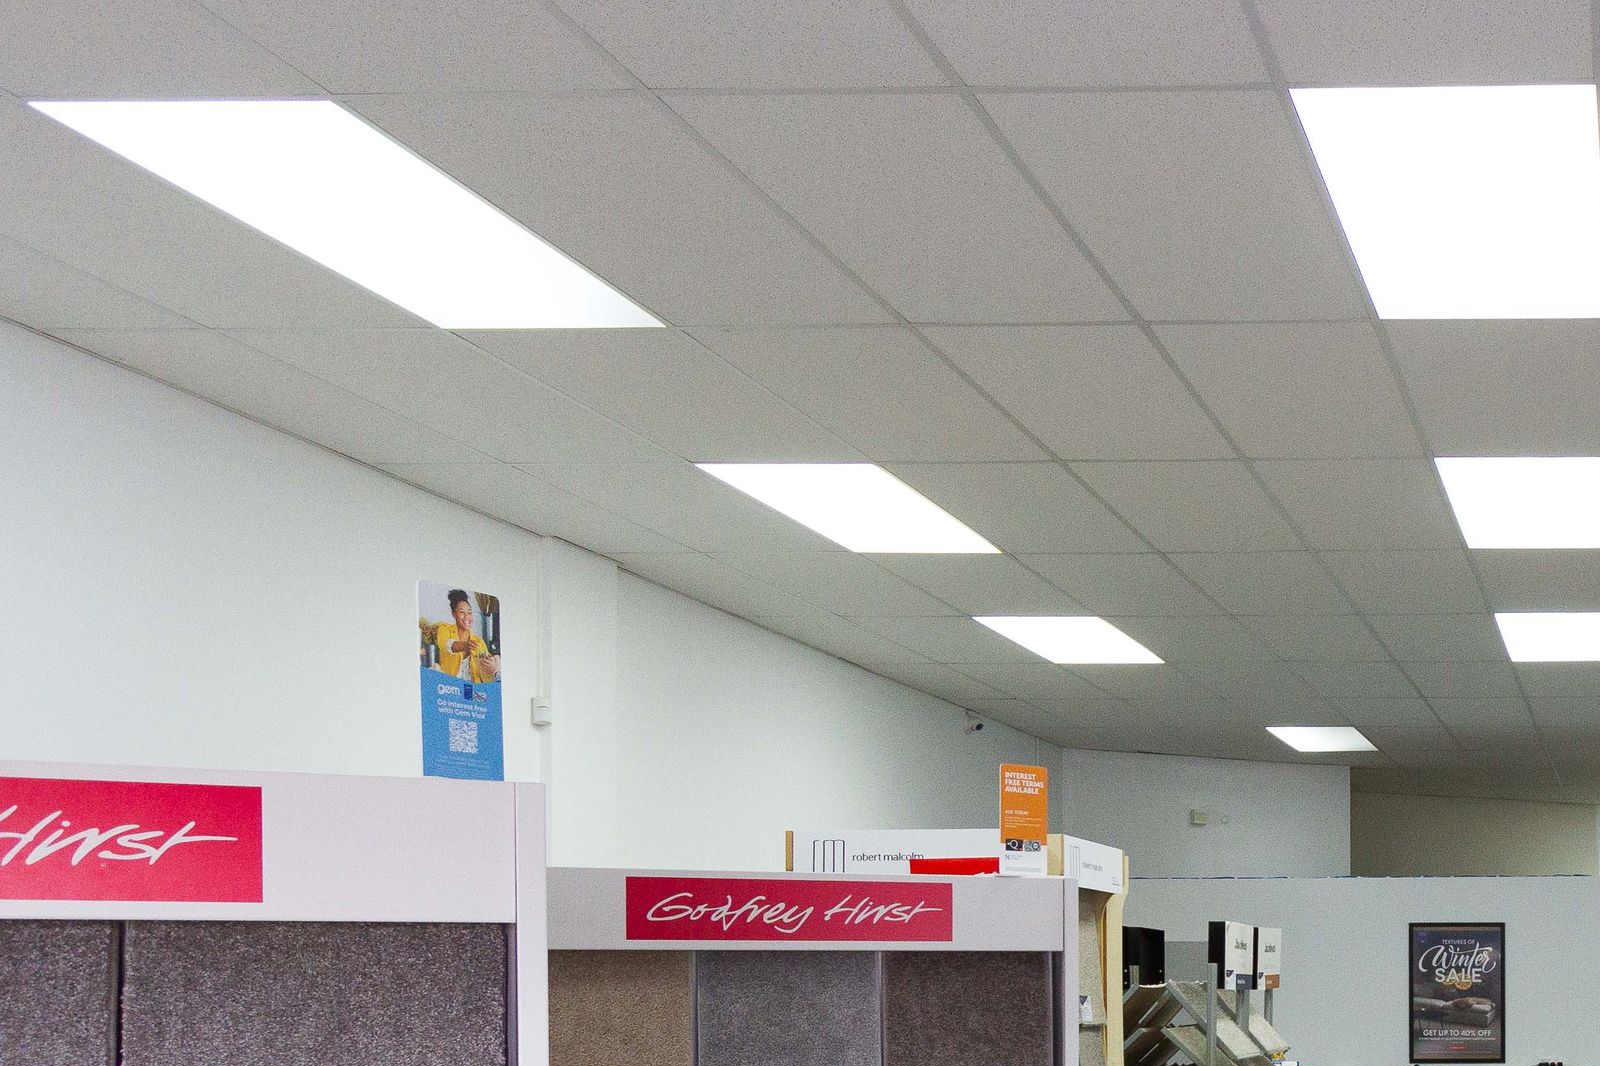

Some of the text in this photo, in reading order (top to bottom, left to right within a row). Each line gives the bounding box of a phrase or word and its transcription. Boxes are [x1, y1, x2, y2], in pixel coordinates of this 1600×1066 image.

[436, 684, 460, 695] gem
[1004, 771, 1037, 780] INTEREST
[1004, 778, 1045, 789] FREE TERMS
[1004, 785, 1040, 795] AVAILABLE
[852, 851, 924, 862] robert malcolm
[646, 892, 944, 934] Godfrey Hirst
[1418, 942, 1497, 973] Winter
[1435, 968, 1482, 982] SALE
[1423, 1029, 1492, 1037] GET UP TO 40% OFF
